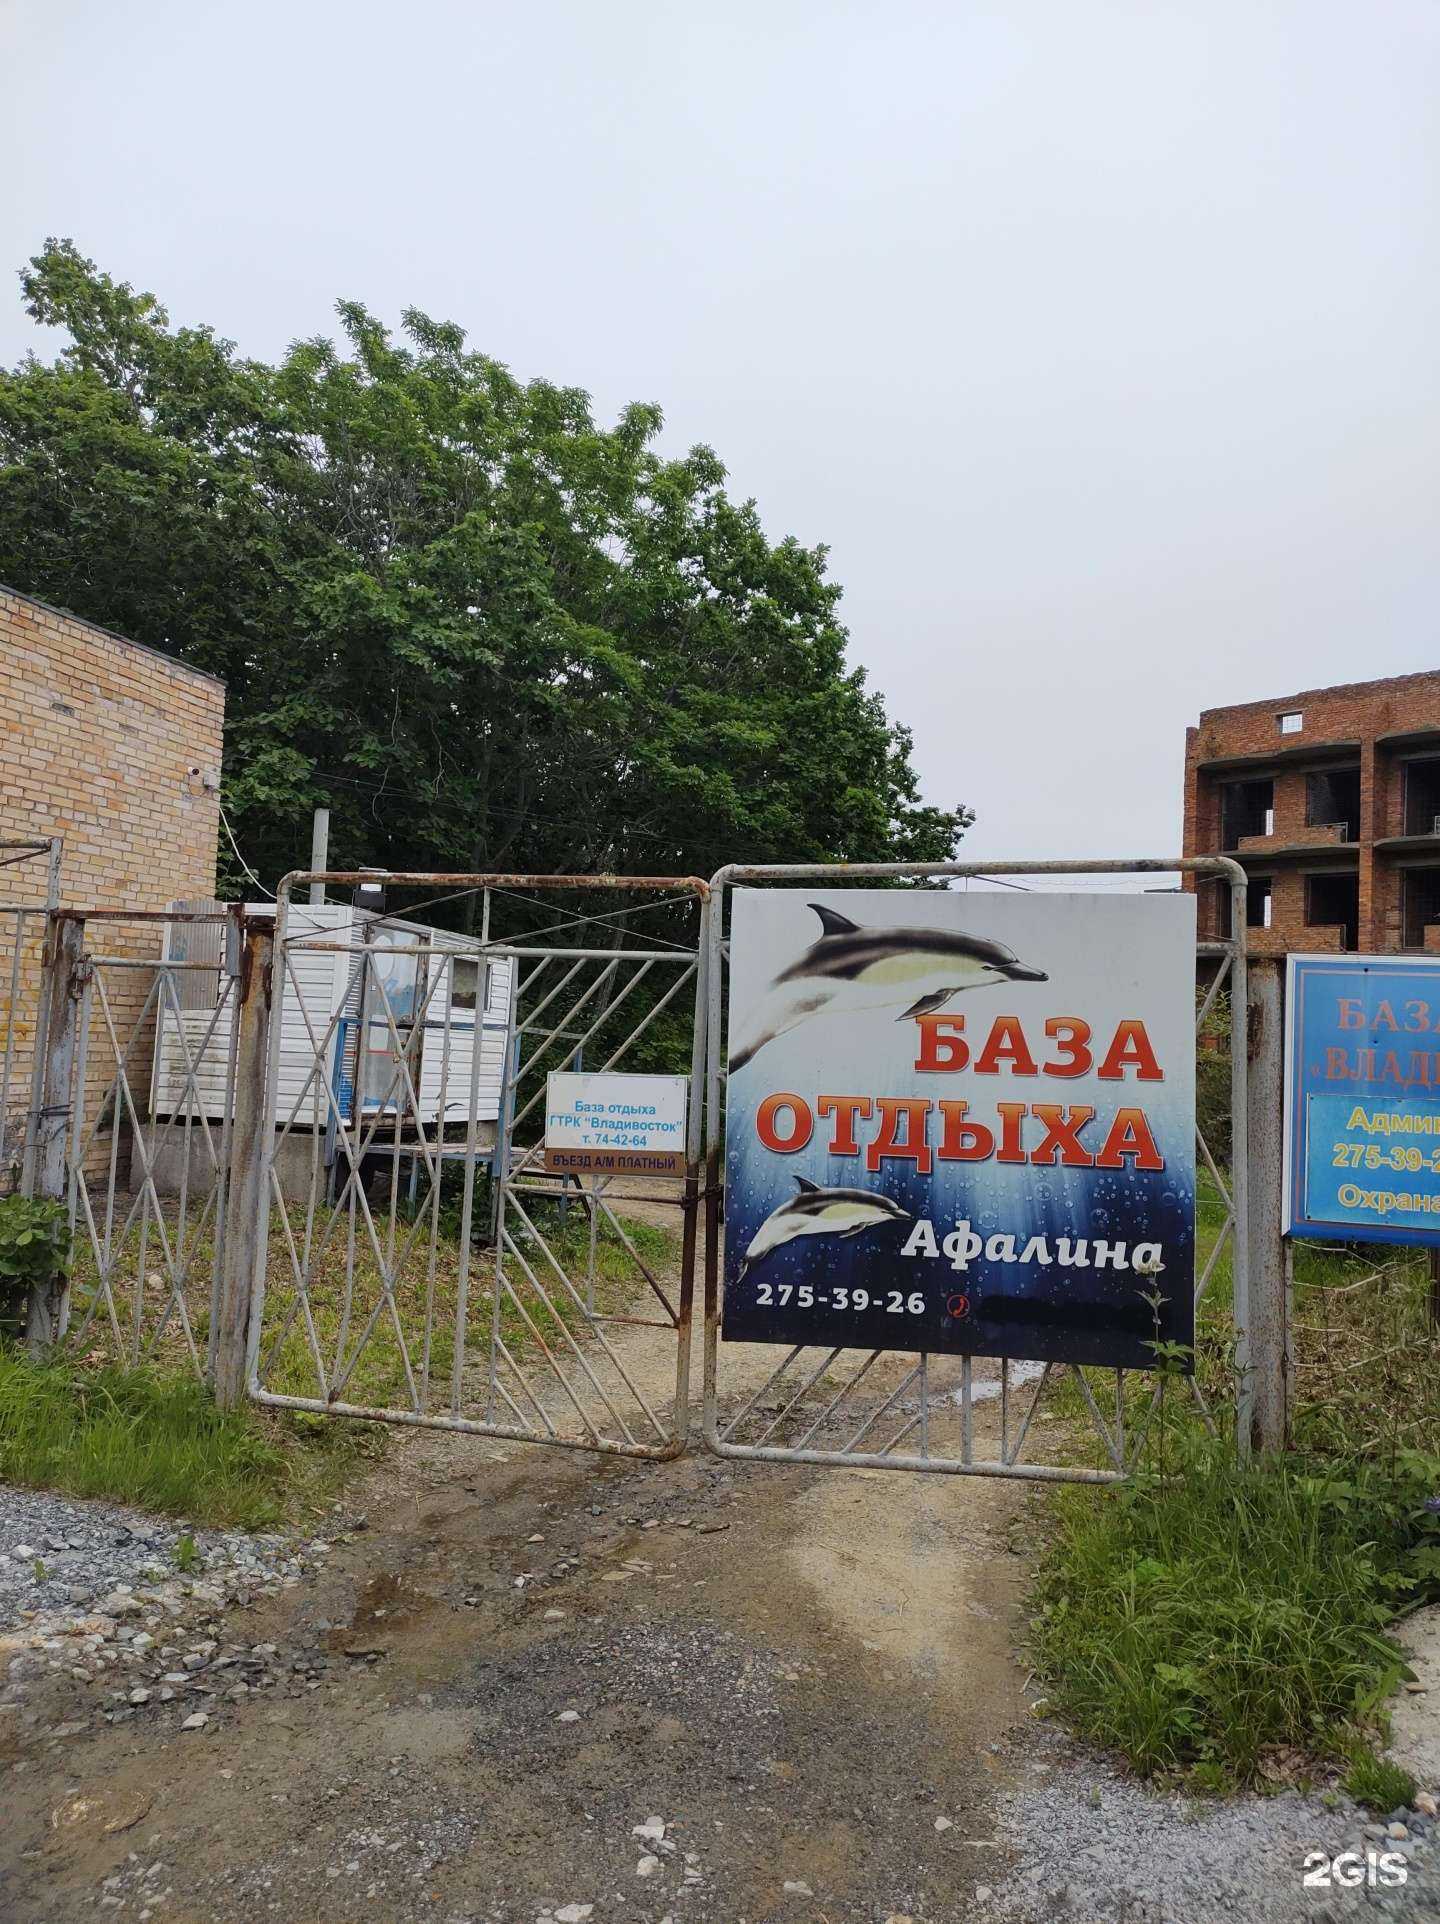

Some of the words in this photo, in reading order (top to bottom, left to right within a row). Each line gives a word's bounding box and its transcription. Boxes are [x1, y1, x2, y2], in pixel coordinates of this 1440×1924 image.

[914, 1014, 1165, 1081] БАЗА
[575, 1101, 604, 1112] База
[608, 1104, 656, 1115] отдыха
[550, 1115, 581, 1127] ГТРК
[595, 1134, 647, 1146] 74-42-64
[755, 1092, 1164, 1174] ОТДЫХА
[553, 1154, 591, 1167] ВЪЕЗД
[618, 1156, 675, 1170] ПЛАТНЫЙ
[900, 1219, 1166, 1270] Афалина
[756, 1283, 926, 1314] 275-39-26
